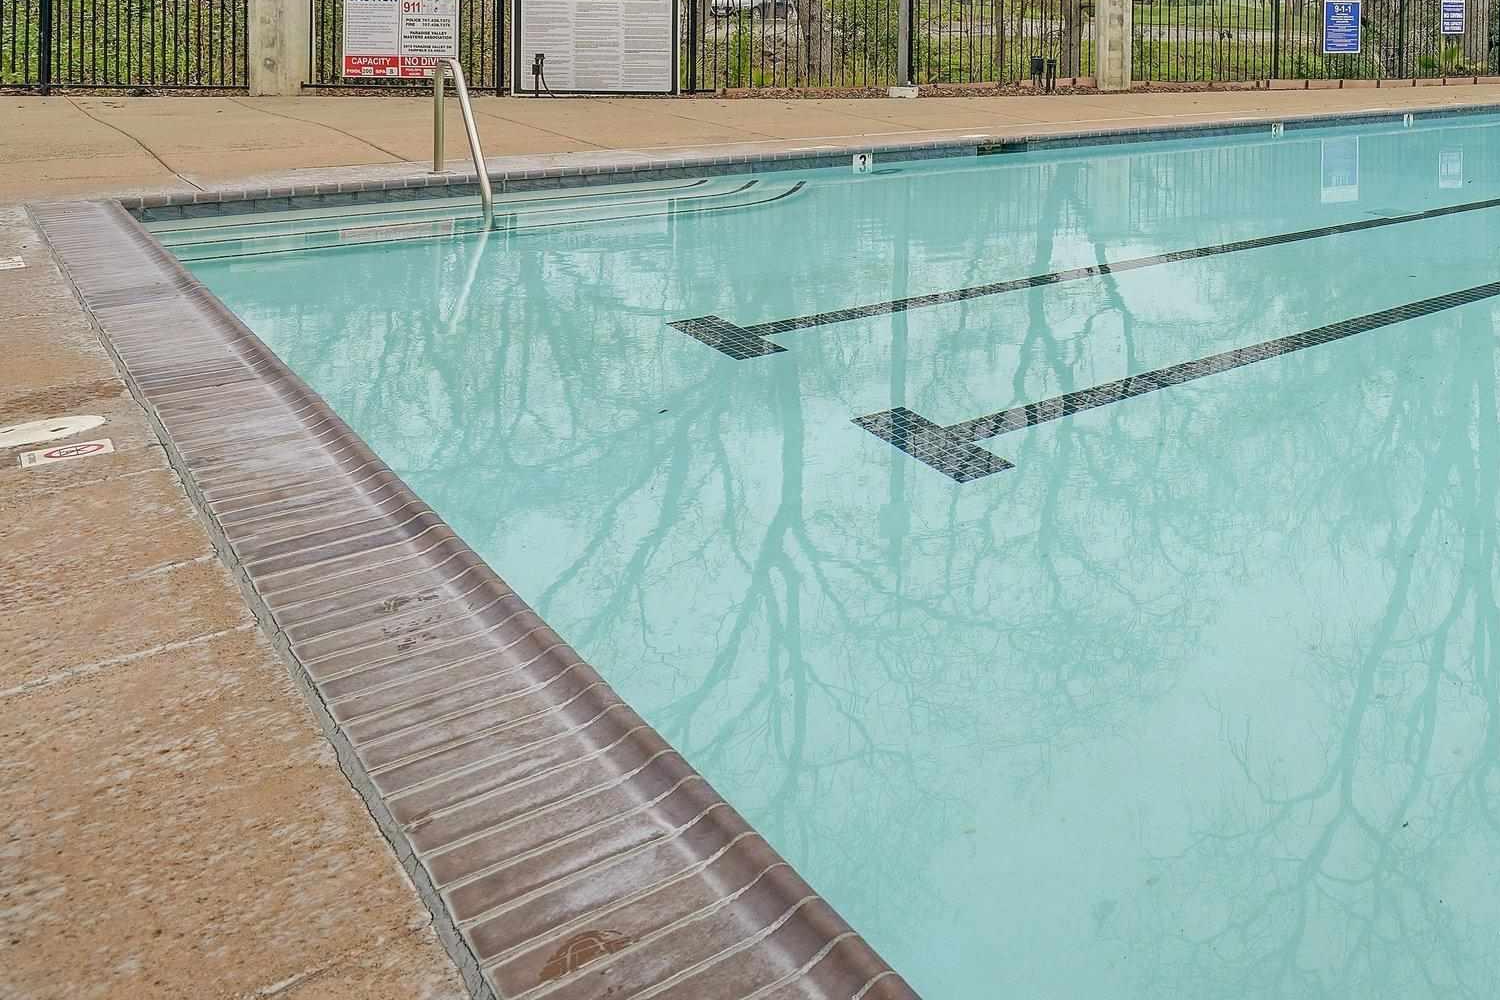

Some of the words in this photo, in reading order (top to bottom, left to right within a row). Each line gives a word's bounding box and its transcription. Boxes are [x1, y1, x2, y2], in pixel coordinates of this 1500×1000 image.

[403, 1, 422, 13] 911
[1334, 5, 1352, 13] 9-1-1
[351, 57, 391, 66] CAPACITY
[404, 57, 419, 66] NO
